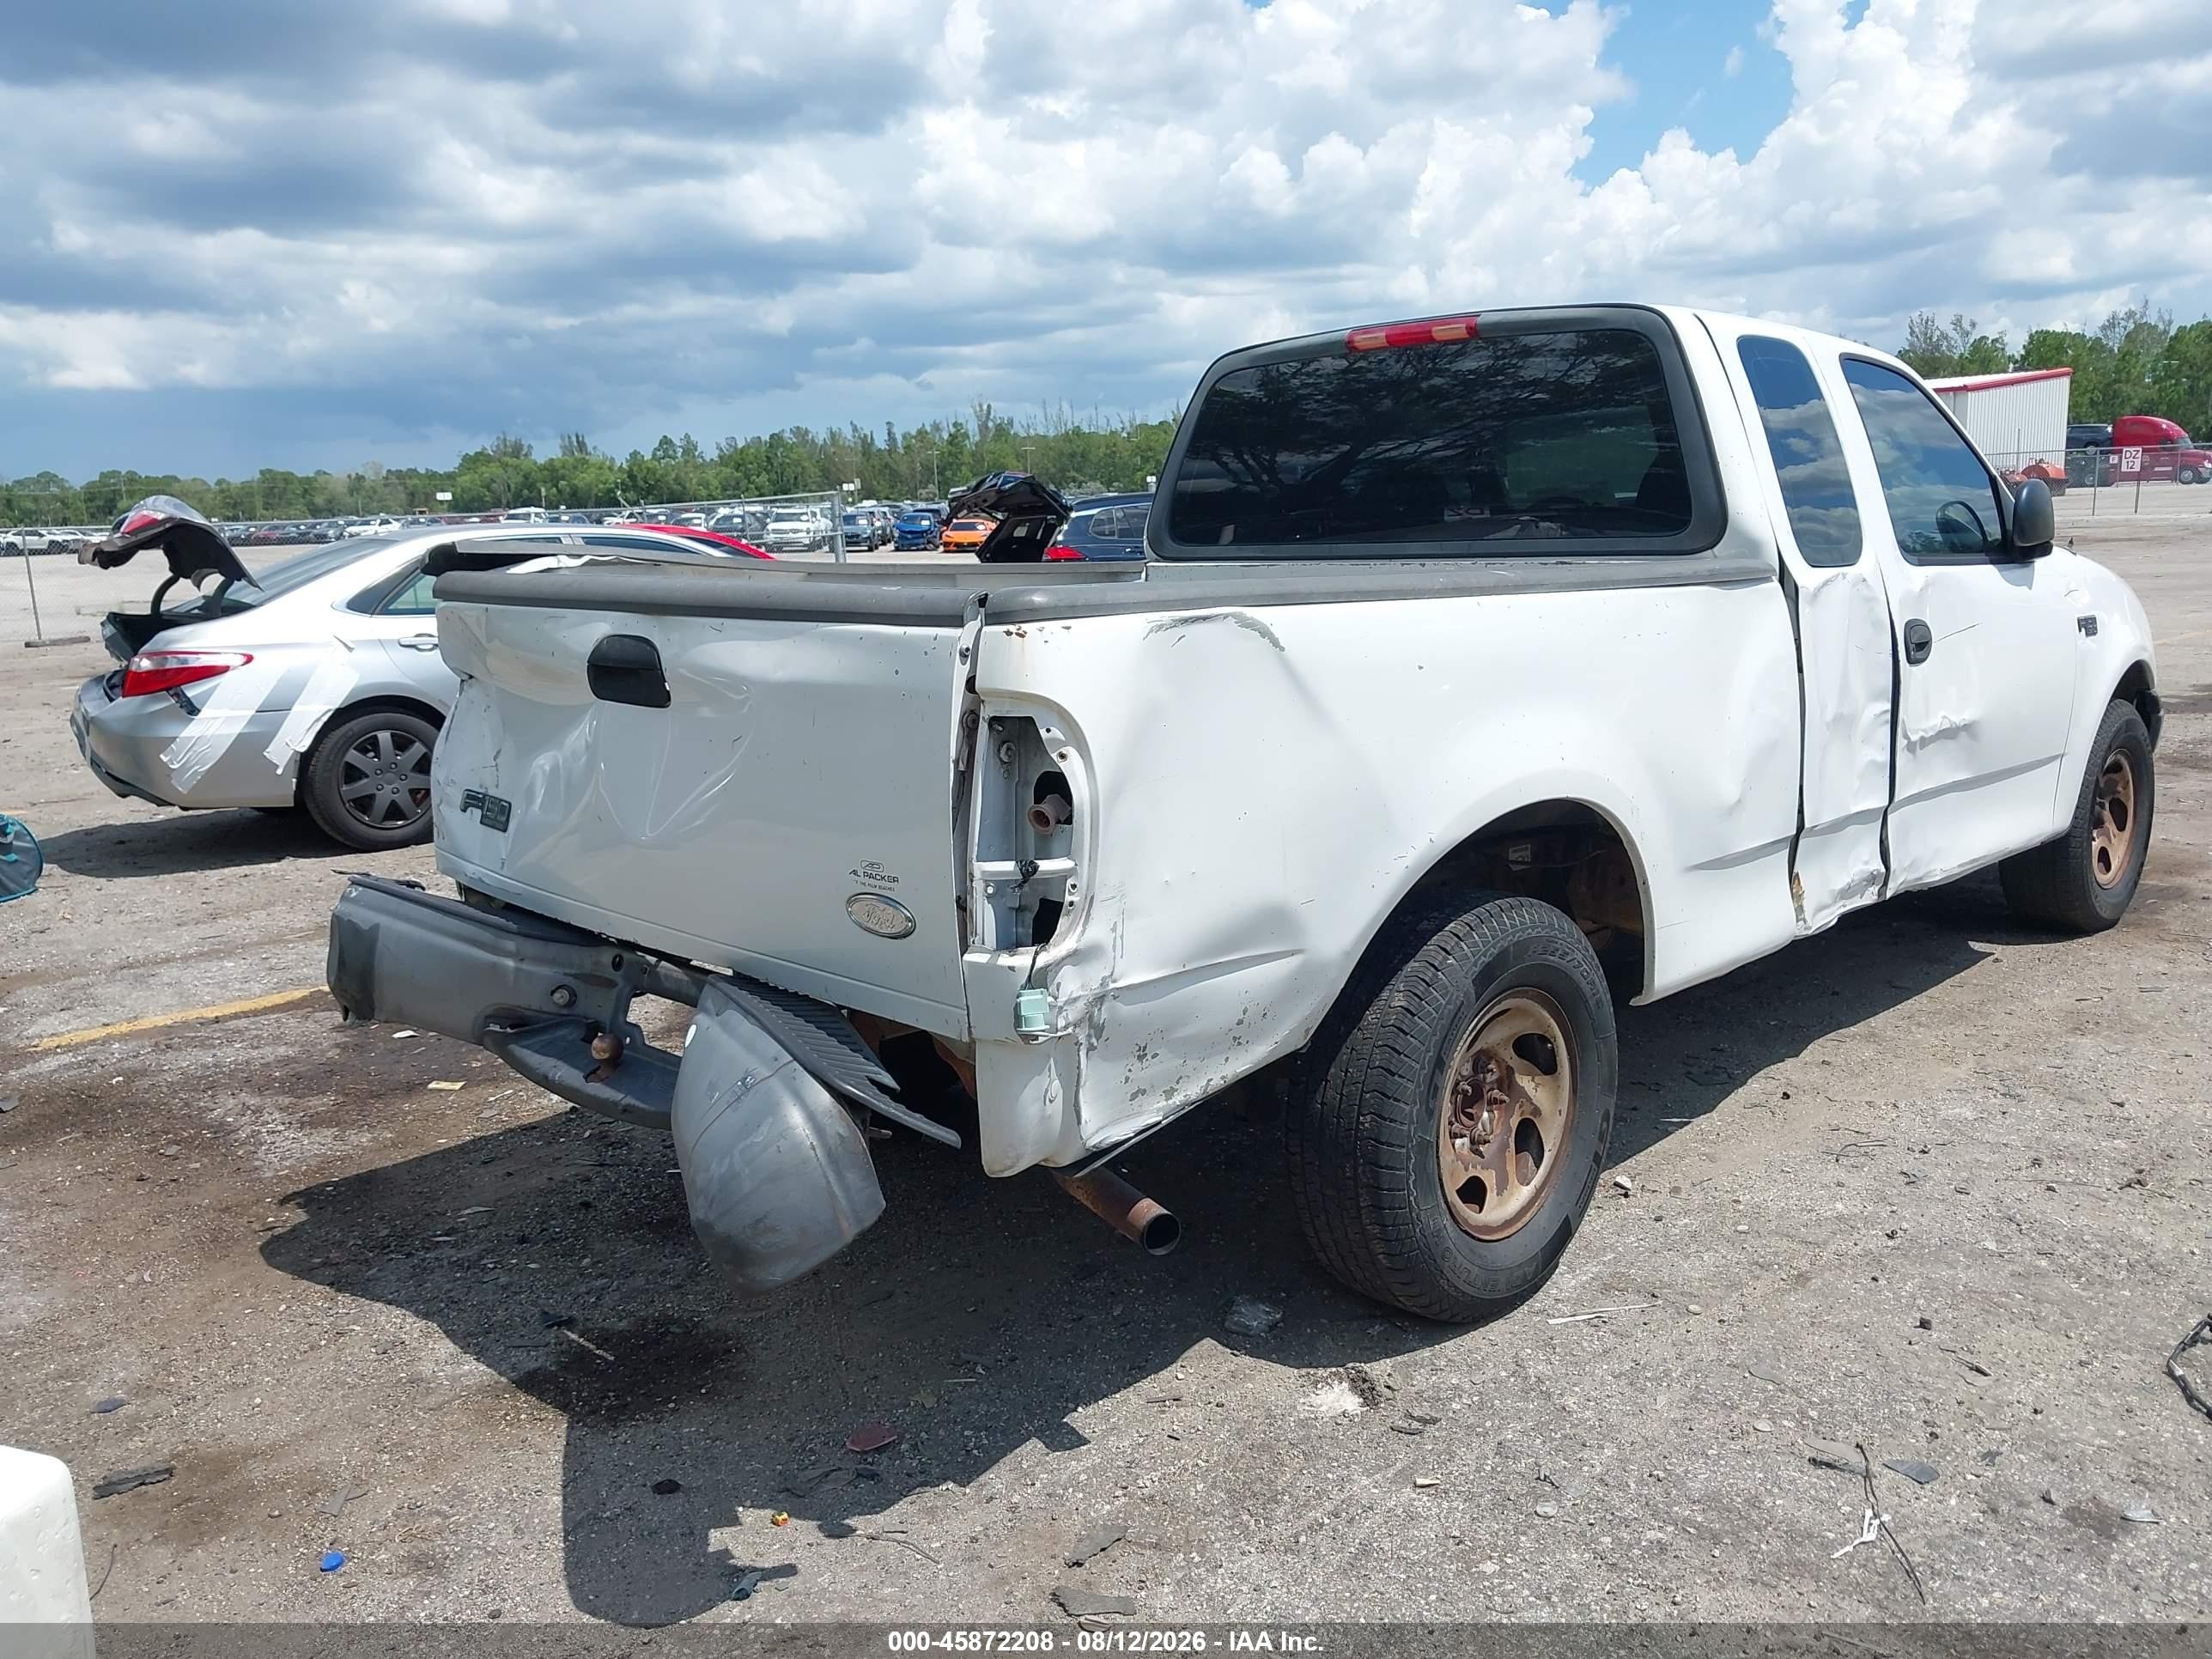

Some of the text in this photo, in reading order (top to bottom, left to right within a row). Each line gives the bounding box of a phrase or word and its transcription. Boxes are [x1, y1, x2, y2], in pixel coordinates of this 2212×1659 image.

[2124, 450, 2140, 459] DZ
[2125, 461, 2136, 470] 12
[848, 869, 899, 884] AL PACKER
